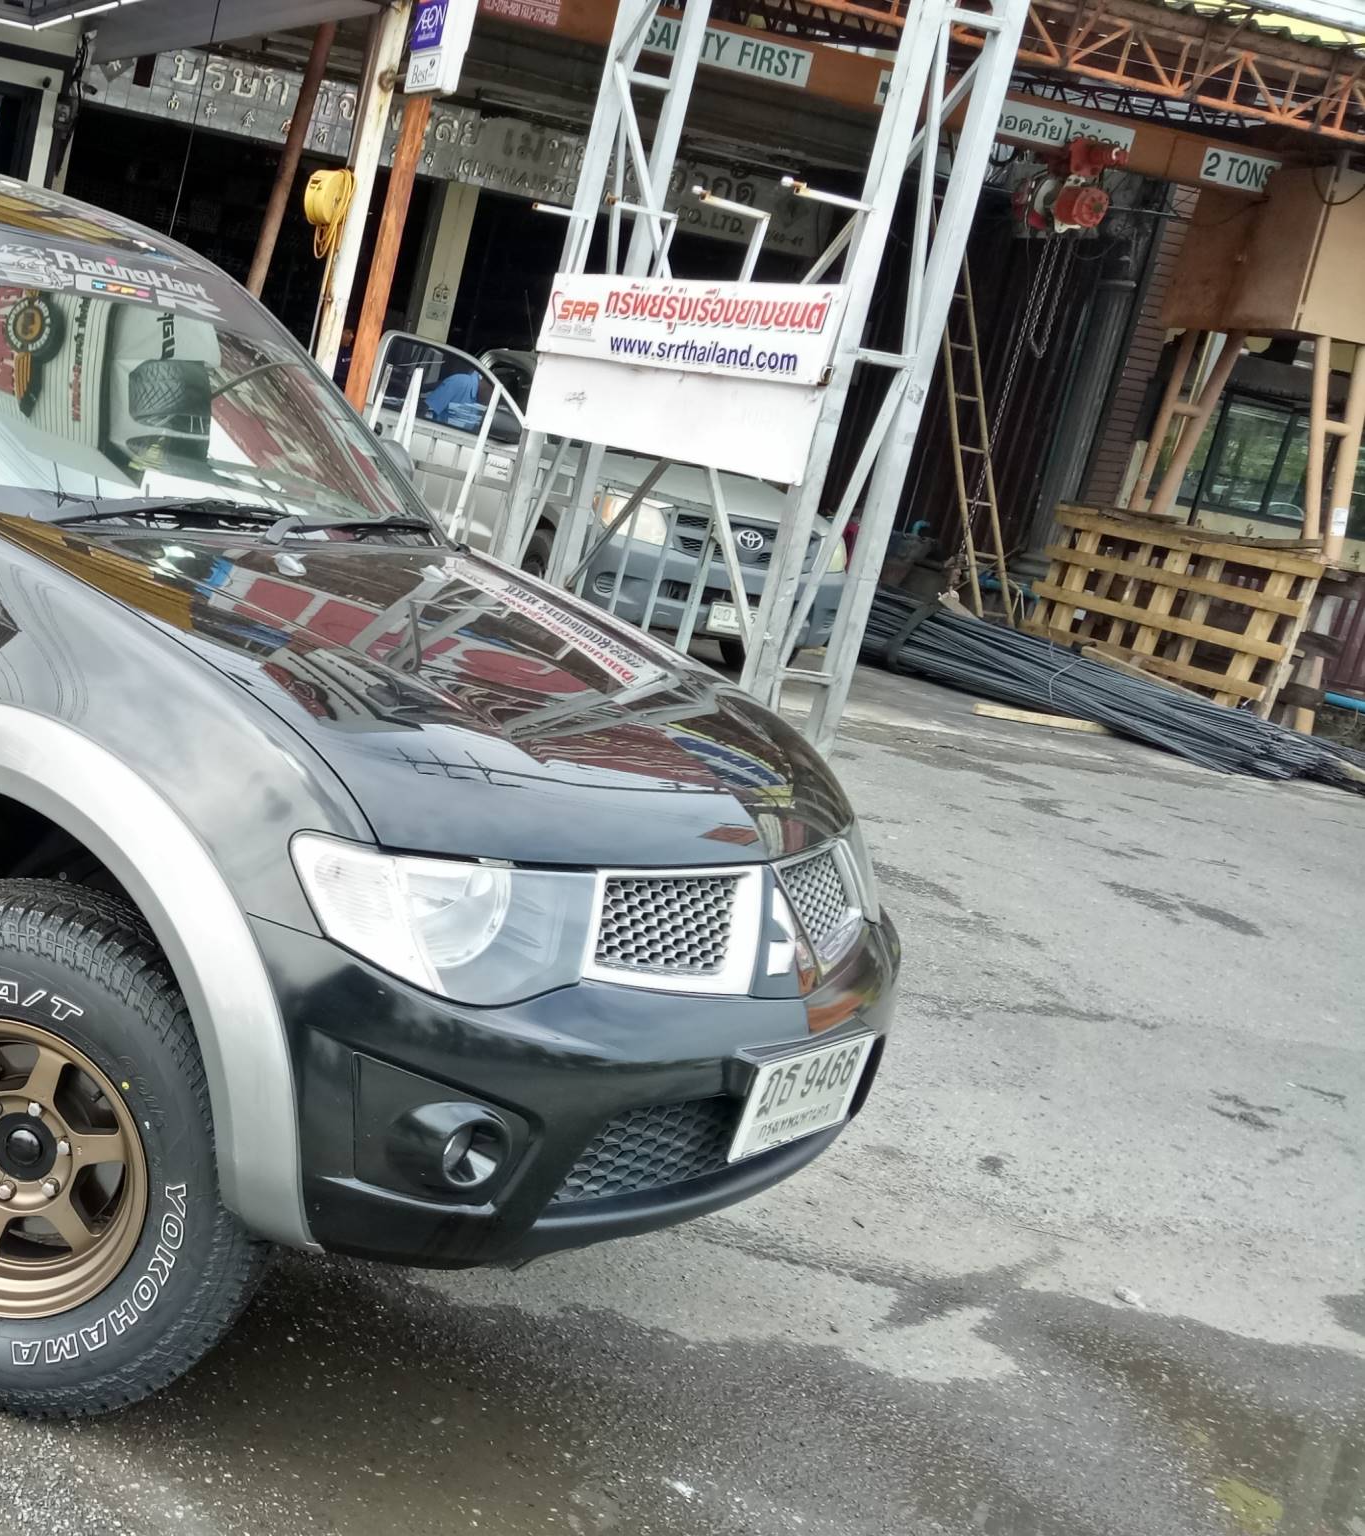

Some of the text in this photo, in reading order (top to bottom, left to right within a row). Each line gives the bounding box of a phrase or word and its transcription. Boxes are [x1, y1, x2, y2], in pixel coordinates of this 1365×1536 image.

[411, 63, 429, 85] Best
[644, 18, 805, 80] SATY FIRST
[1203, 152, 1276, 188] 2 TONS
[46, 248, 215, 301] RacingHart
[609, 335, 798, 372] www.srrthailand.com
[800, 1046, 860, 1099] 9466
[12, 1182, 190, 1366] YOKOHAMA
